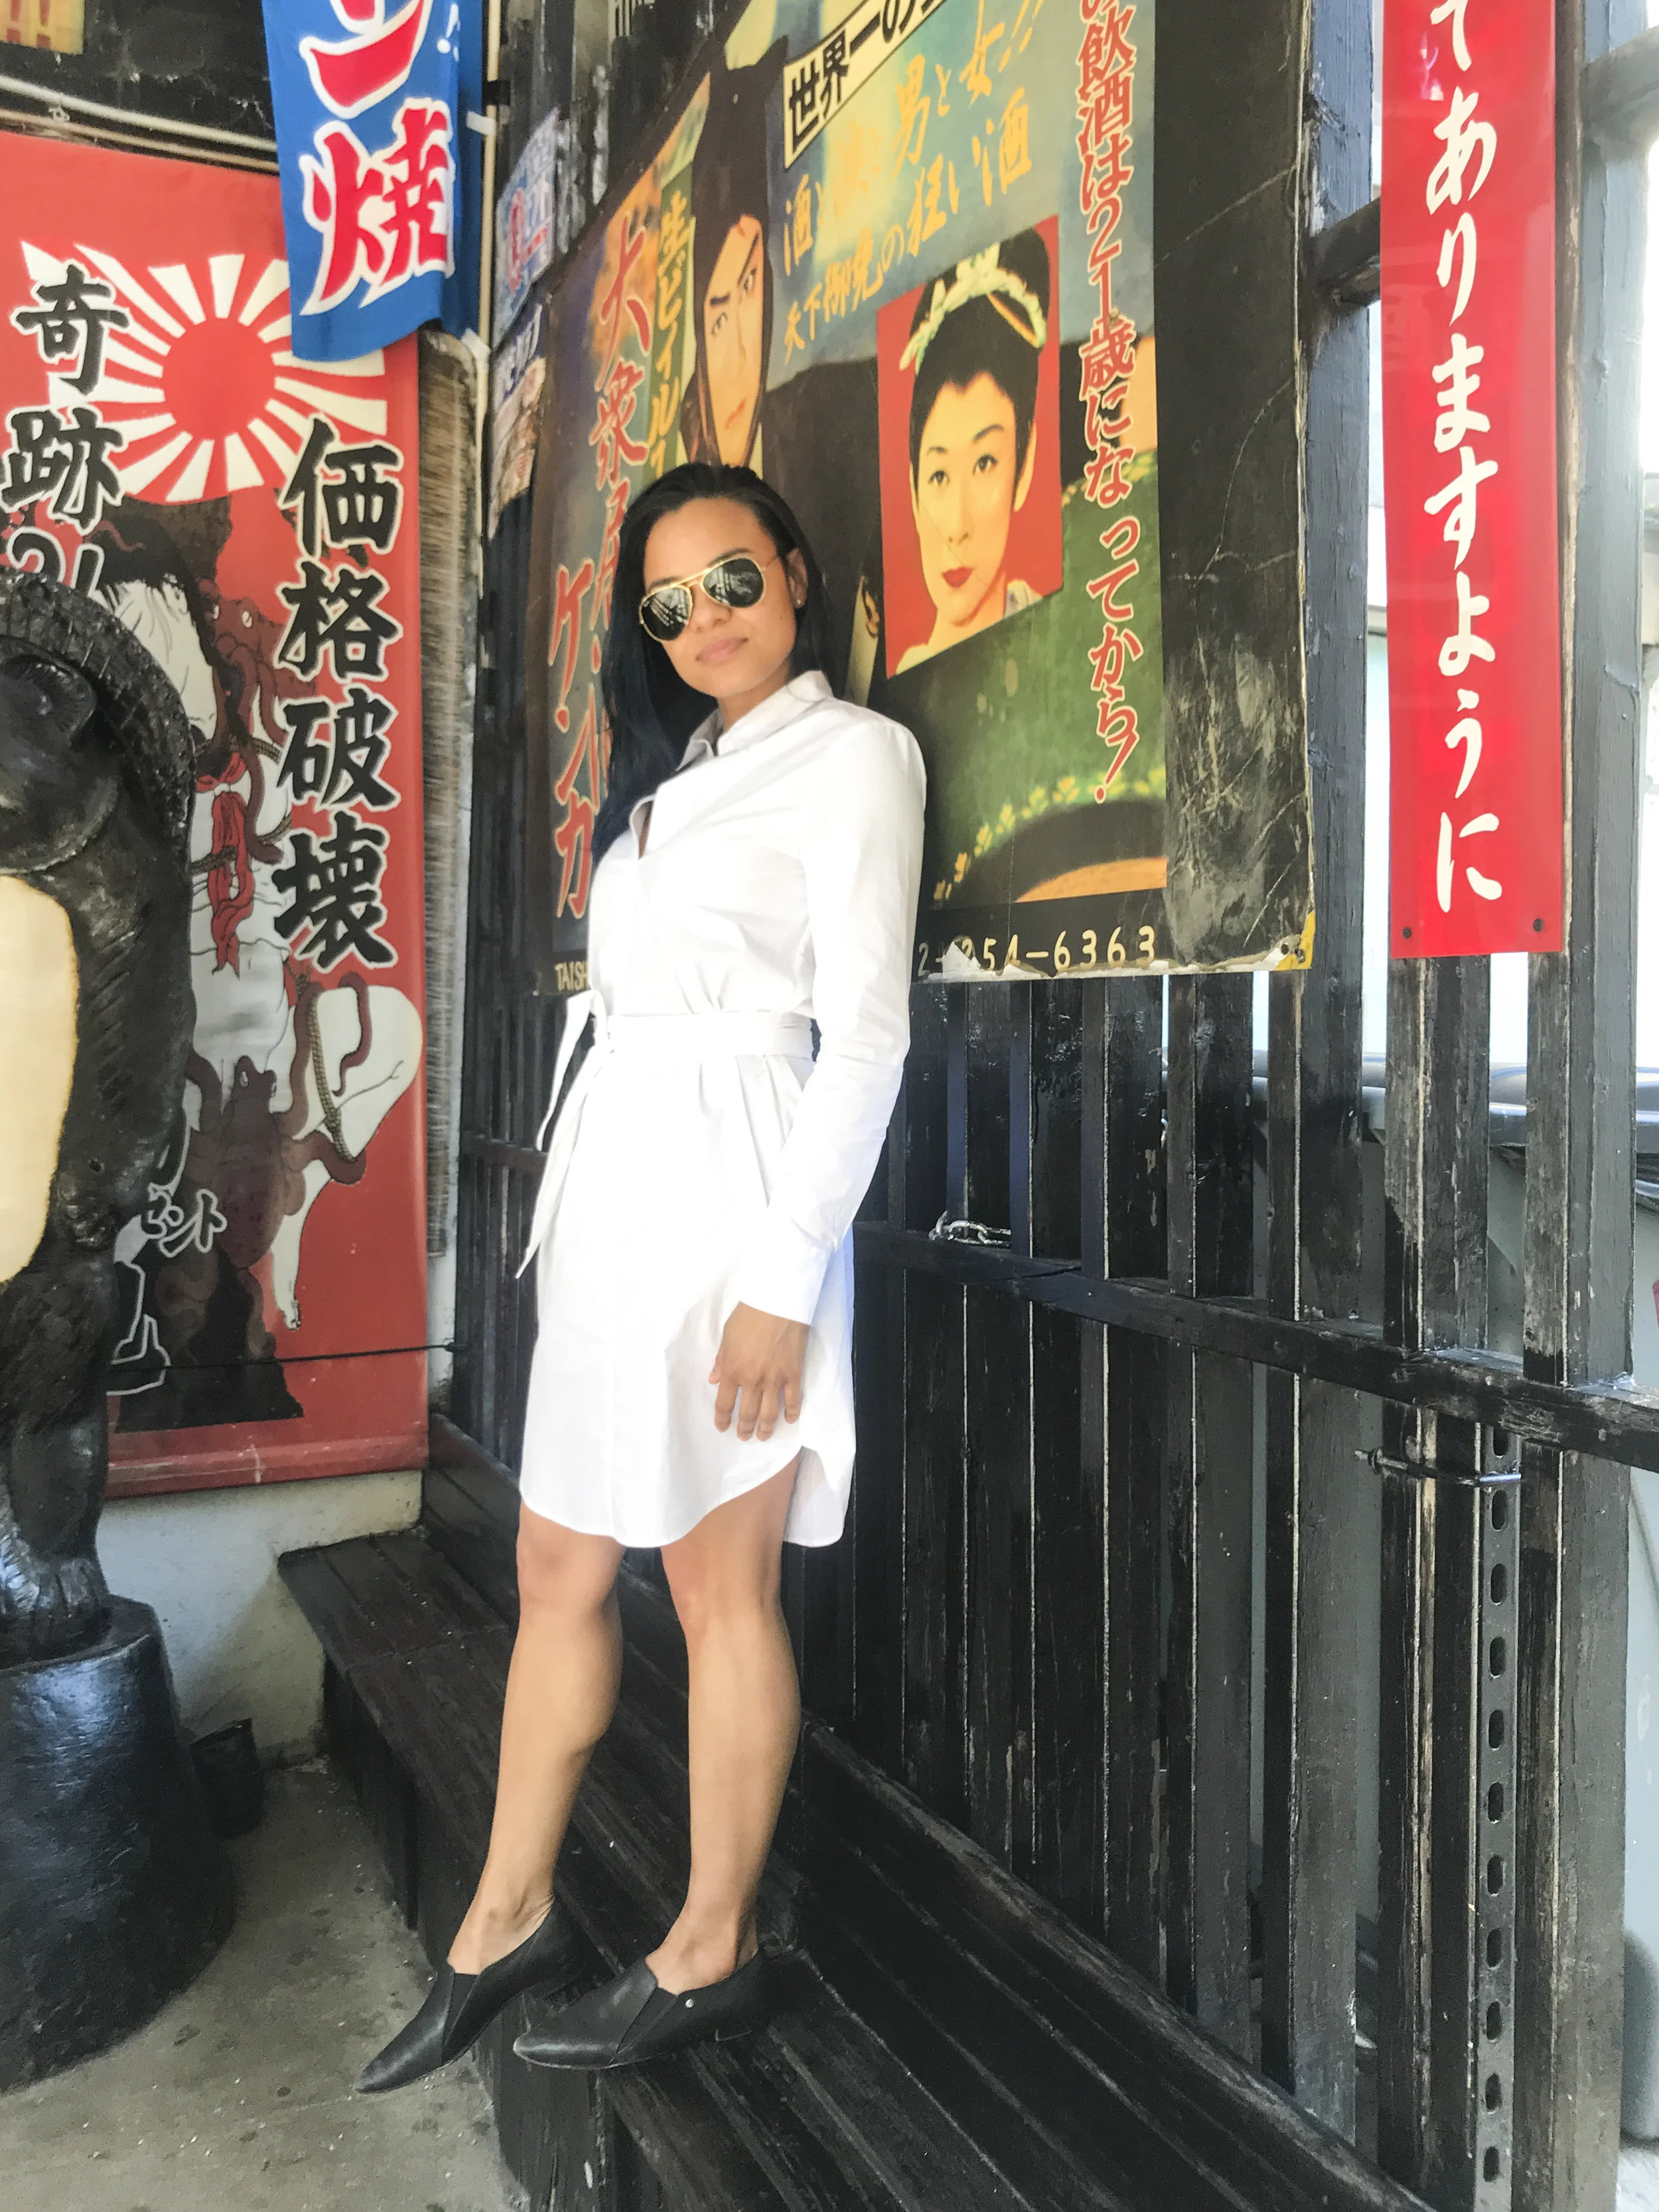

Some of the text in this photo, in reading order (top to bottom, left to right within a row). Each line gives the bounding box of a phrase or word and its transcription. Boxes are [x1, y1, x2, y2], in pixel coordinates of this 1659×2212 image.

[788, 0, 945, 158] 世界一の
[273, 411, 404, 970] 価格破壊
